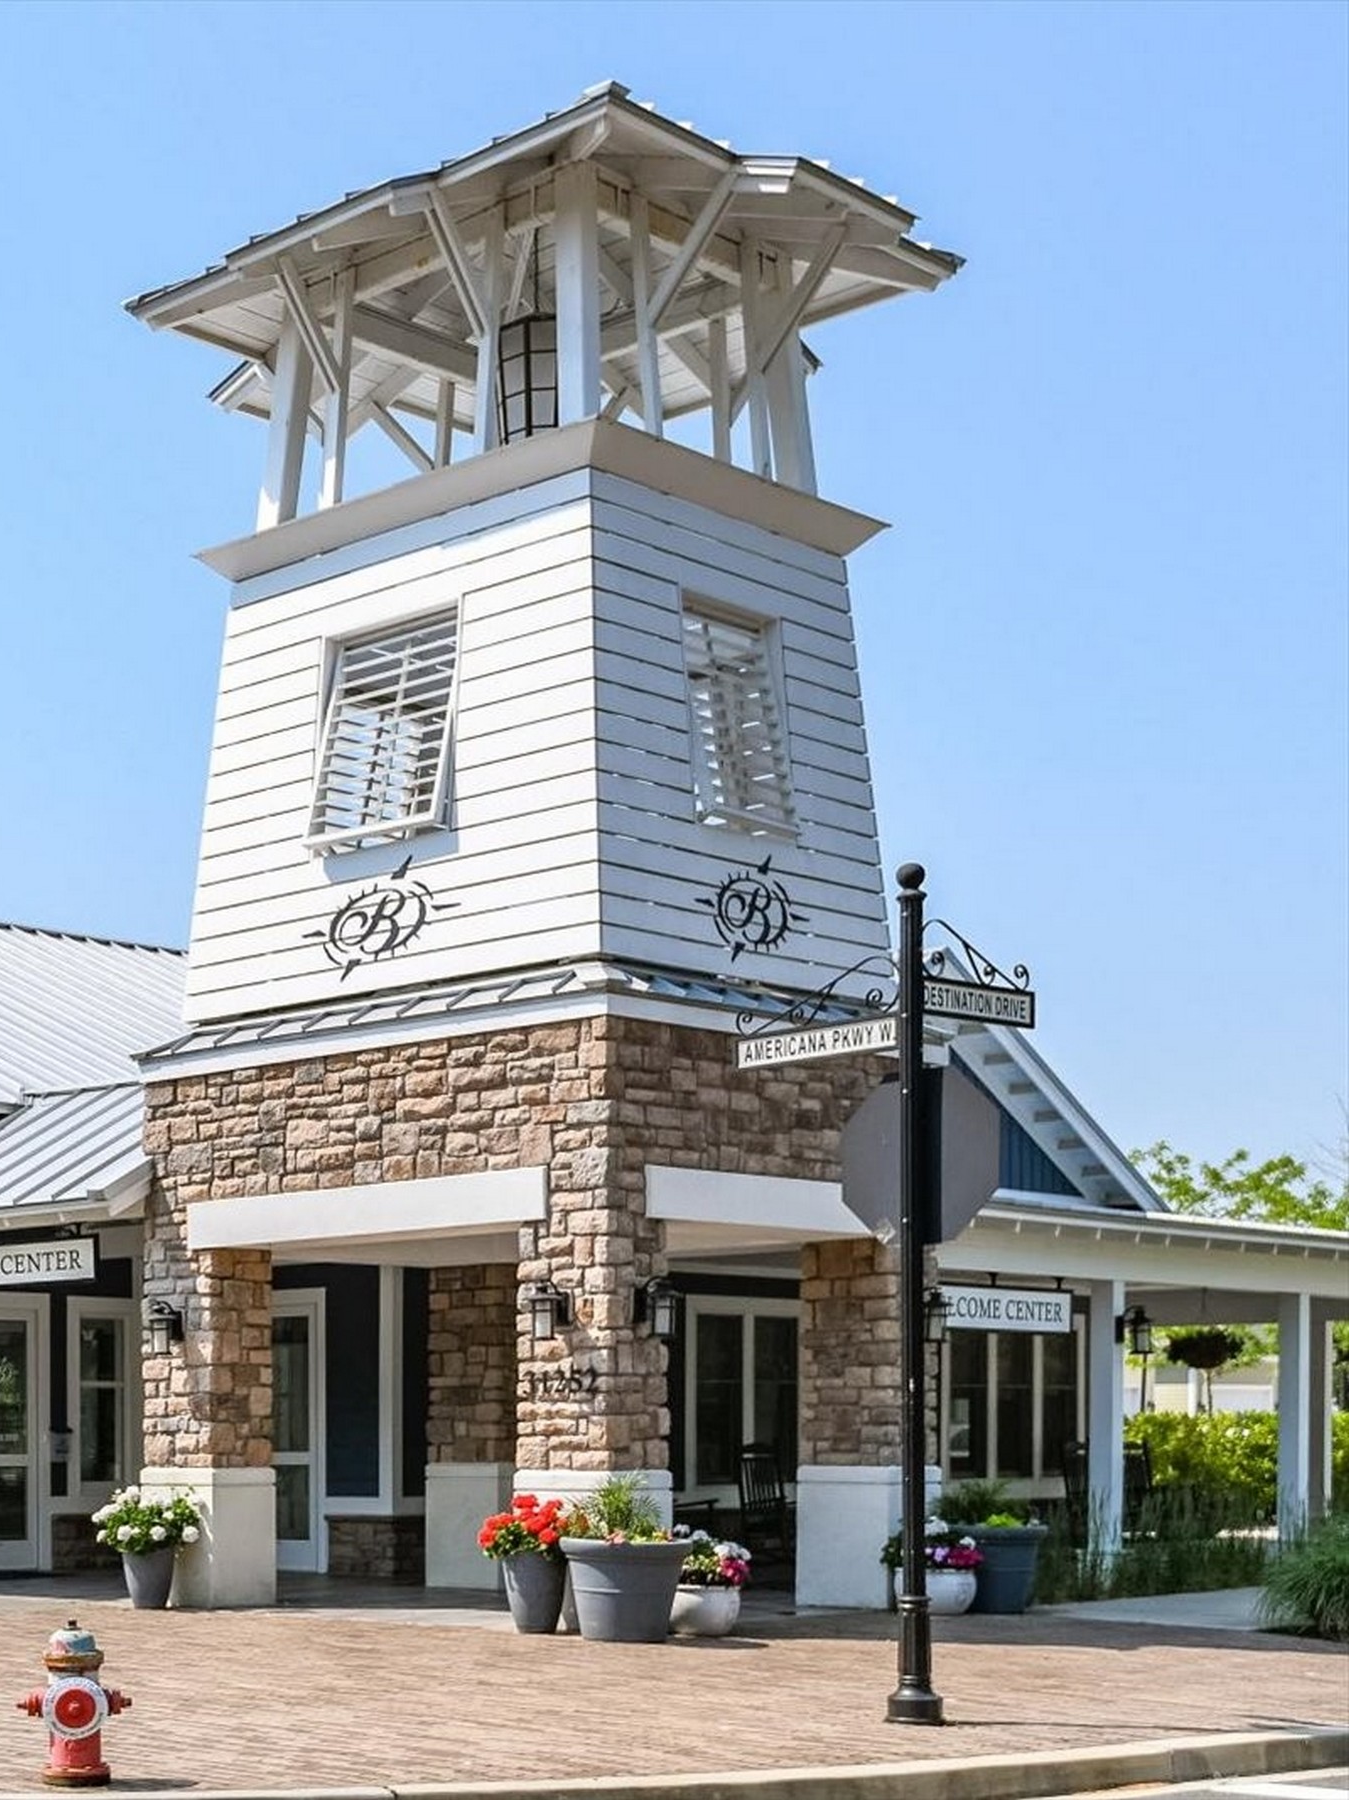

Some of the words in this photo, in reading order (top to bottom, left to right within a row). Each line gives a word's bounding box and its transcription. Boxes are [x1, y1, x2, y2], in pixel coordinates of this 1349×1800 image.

[923, 985, 992, 1014] DESTINATION
[995, 996, 1027, 1020] DRIVE
[744, 1032, 827, 1063] AMERICANA
[832, 1025, 873, 1049] PKWY
[0, 1249, 82, 1275] CENTER
[943, 1296, 1001, 1319] LCOME
[1005, 1300, 1063, 1323] CENTER
